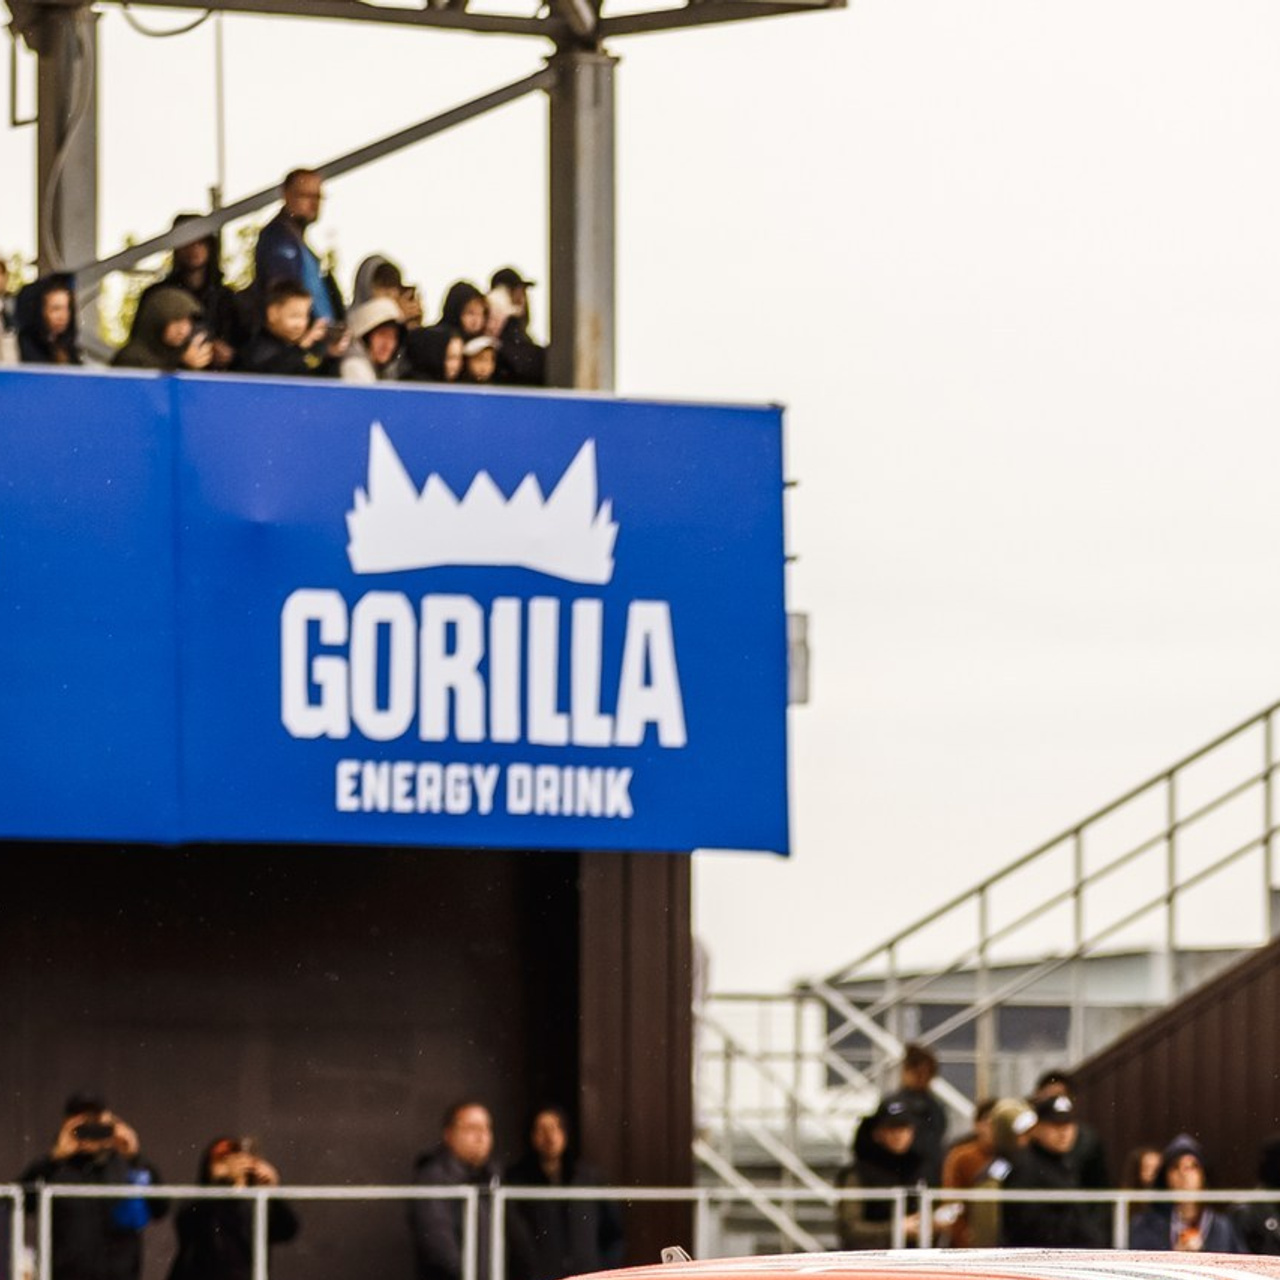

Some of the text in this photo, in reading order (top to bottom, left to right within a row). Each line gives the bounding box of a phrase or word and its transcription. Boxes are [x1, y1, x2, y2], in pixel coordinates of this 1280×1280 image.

[281, 588, 687, 748] GORILLA
[336, 759, 634, 818] ENERGY DRINK
